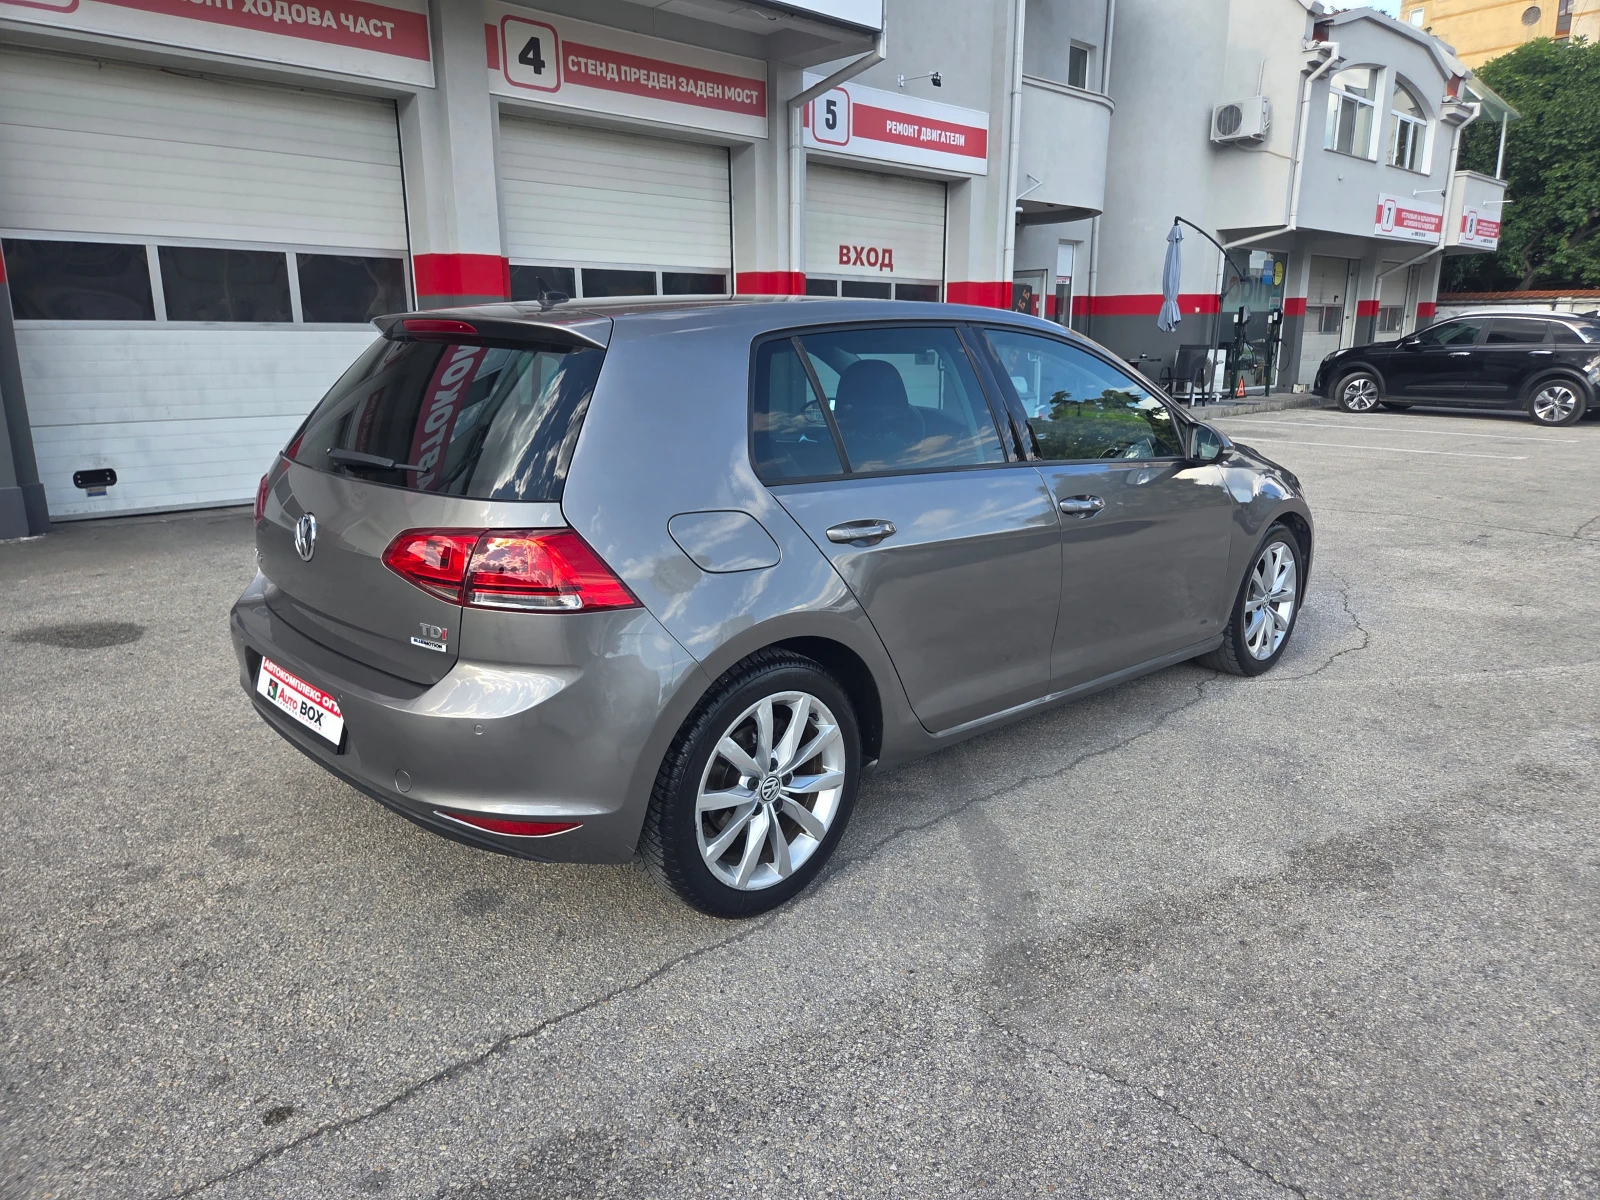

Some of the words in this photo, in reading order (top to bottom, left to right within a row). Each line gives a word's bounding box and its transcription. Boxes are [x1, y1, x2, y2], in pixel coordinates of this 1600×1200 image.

[242, 0, 337, 29] ХОДОВА
[340, 12, 394, 40] ЧАСТ
[518, 36, 545, 75] 4
[568, 55, 619, 82] СТЕНД
[620, 65, 676, 90] ПРЕДЕН
[678, 76, 722, 98] ЗАДЕН
[724, 85, 758, 105] МОСТ
[825, 99, 837, 130] 5
[886, 120, 919, 138] РЕМОНТ
[920, 127, 965, 146] ДВИГАТЕЛИ
[1386, 207, 1392, 224] 7
[839, 244, 894, 272] ВХОД
[419, 622, 448, 640] TDI
[265, 659, 321, 702] АВТОКОМПЛЕКС
[299, 700, 324, 727] BOX
